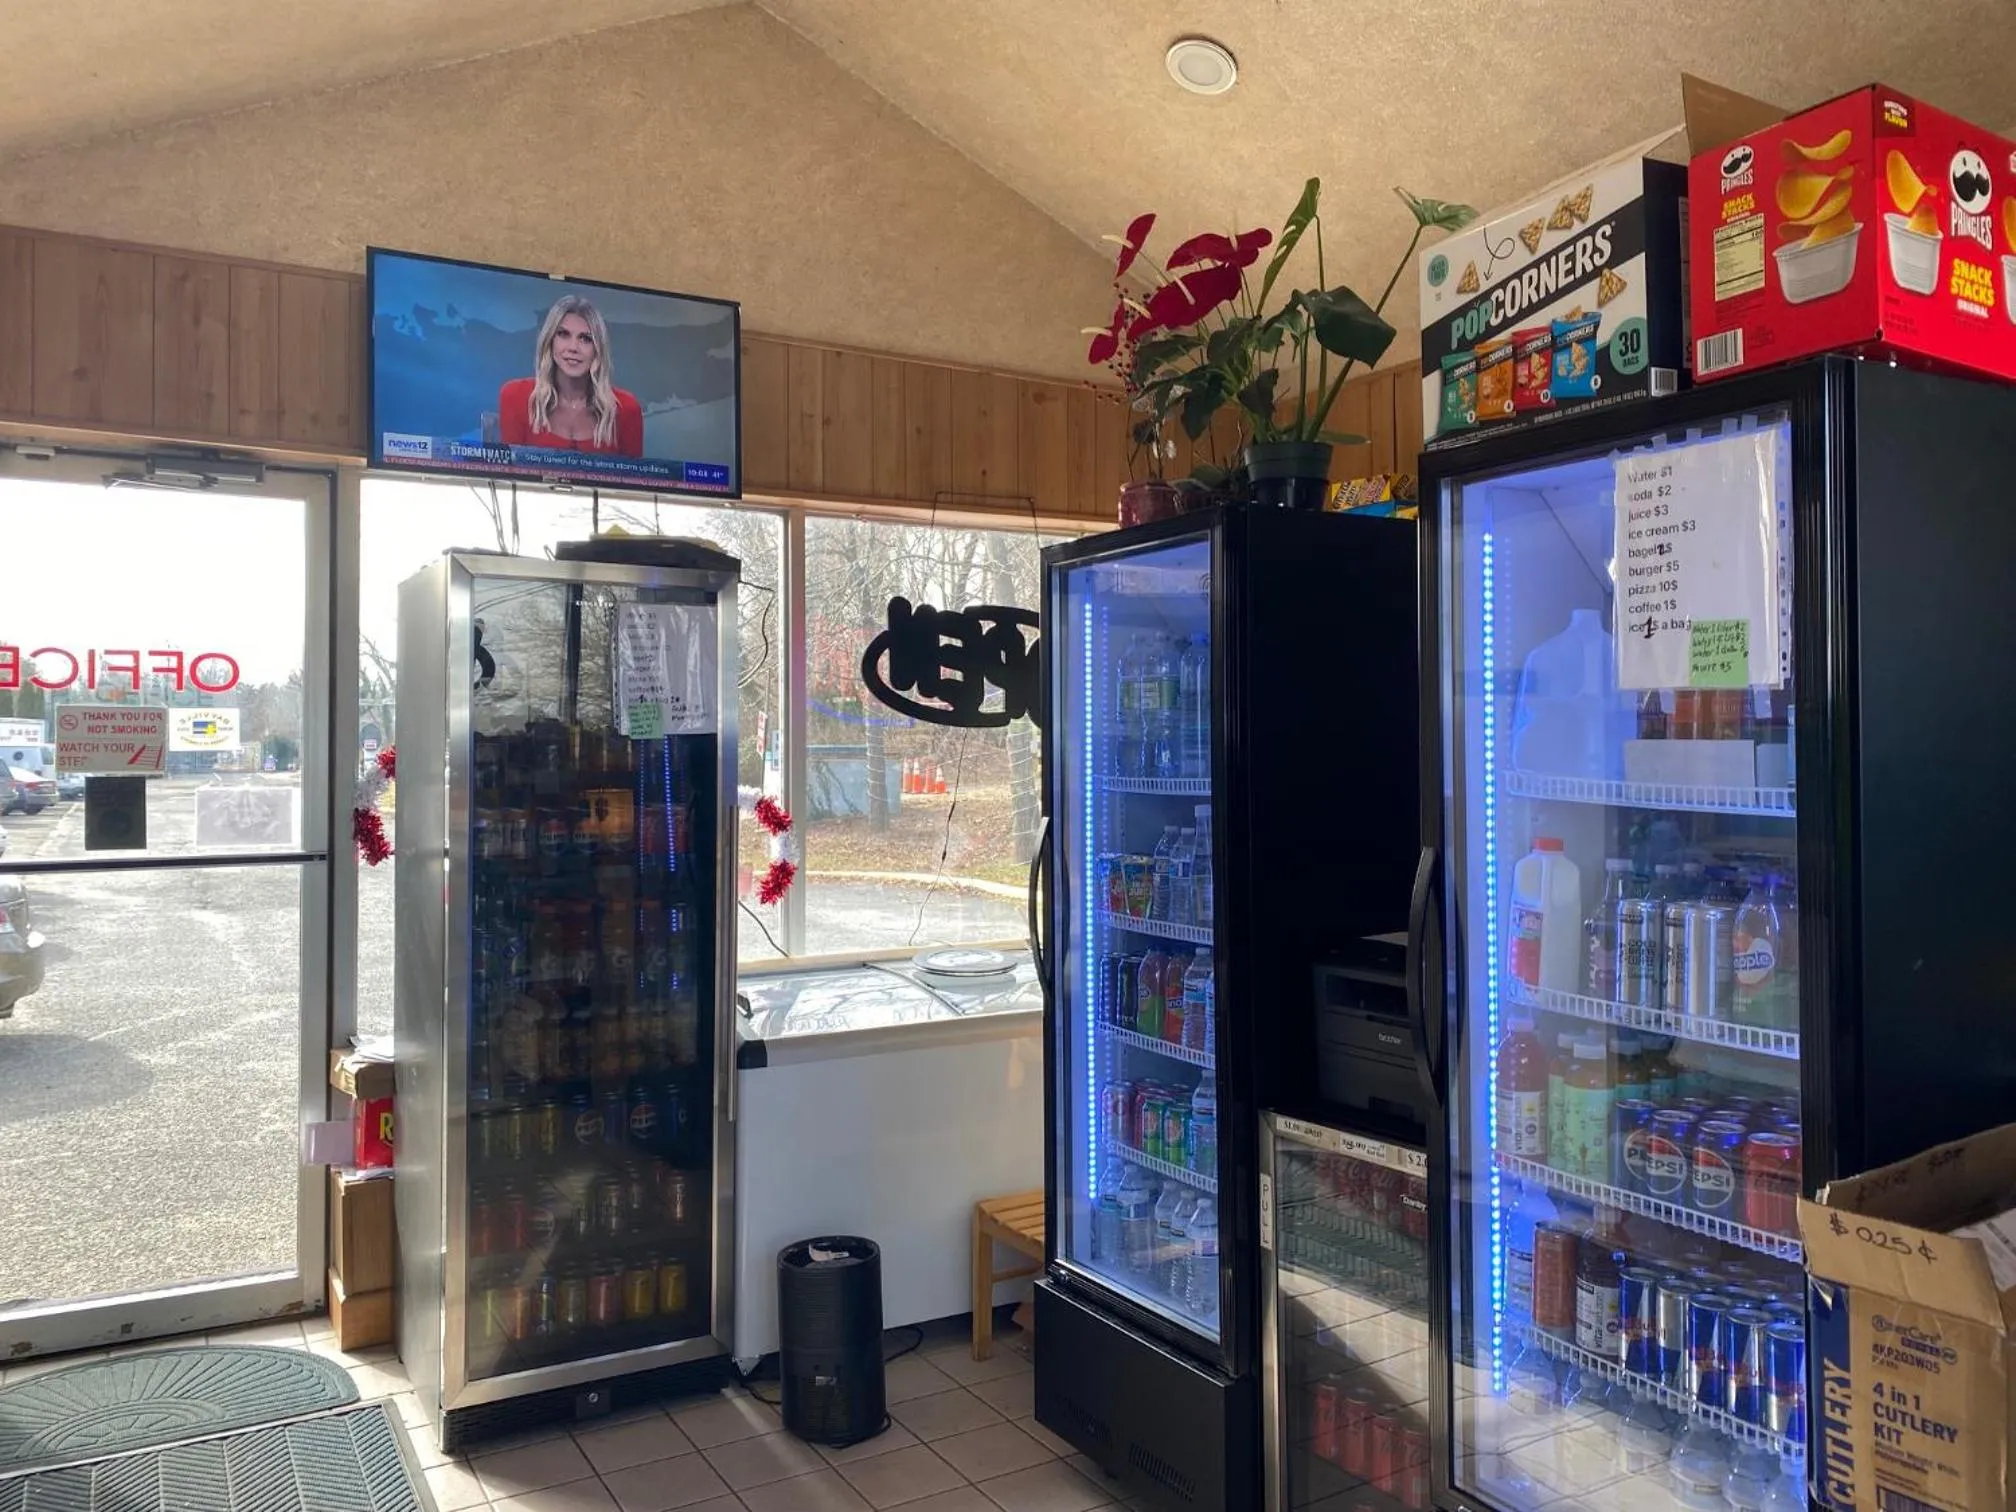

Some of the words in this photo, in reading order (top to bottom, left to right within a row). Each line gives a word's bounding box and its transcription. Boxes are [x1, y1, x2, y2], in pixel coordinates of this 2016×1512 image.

[1720, 168, 1754, 195] PRINGLES
[1950, 202, 1993, 250] PRINGLES
[1952, 257, 1993, 286] SNACK
[1450, 223, 1613, 350] POPCORNERS
[1950, 275, 1995, 307] STACKS
[1618, 327, 1641, 358] 30
[1622, 355, 1640, 368] BAGS
[388, 439, 428, 450] news12
[568, 456, 579, 466] for
[1660, 465, 1673, 478] $1
[1657, 485, 1672, 497] $2
[1654, 504, 1669, 518] $3
[1628, 527, 1644, 540] ice
[1644, 523, 1680, 537] cream
[1682, 520, 1697, 532] $3
[1628, 563, 1664, 578] burger
[1666, 559, 1680, 572] $5
[1628, 582, 1657, 595] pizza
[1659, 579, 1679, 592] 10$
[1628, 600, 1662, 614] coffee
[1664, 598, 1677, 611] 1$
[1628, 620, 1645, 633] ice
[1661, 621, 1669, 630] a
[82, 711, 117, 721] THANK
[120, 711, 140, 721] YOU
[143, 711, 163, 721] FOR
[87, 725, 108, 734] NOT
[110, 724, 157, 735] SMOKING
[58, 742, 100, 753] WATCH
[102, 742, 135, 753] YOUR
[1647, 1156, 1684, 1177] EPSI
[1693, 1169, 1731, 1189] EPSI
[1261, 1182, 1270, 1244] PULL
[1829, 1212, 1849, 1237] $
[1872, 1381, 1885, 1398] 4
[1890, 1385, 1908, 1404] in
[1912, 1394, 1922, 1412] 1
[1824, 1357, 1856, 1506] CUTLERY
[1873, 1400, 1959, 1445] CUTLERY
[1873, 1421, 1904, 1446] KIT
